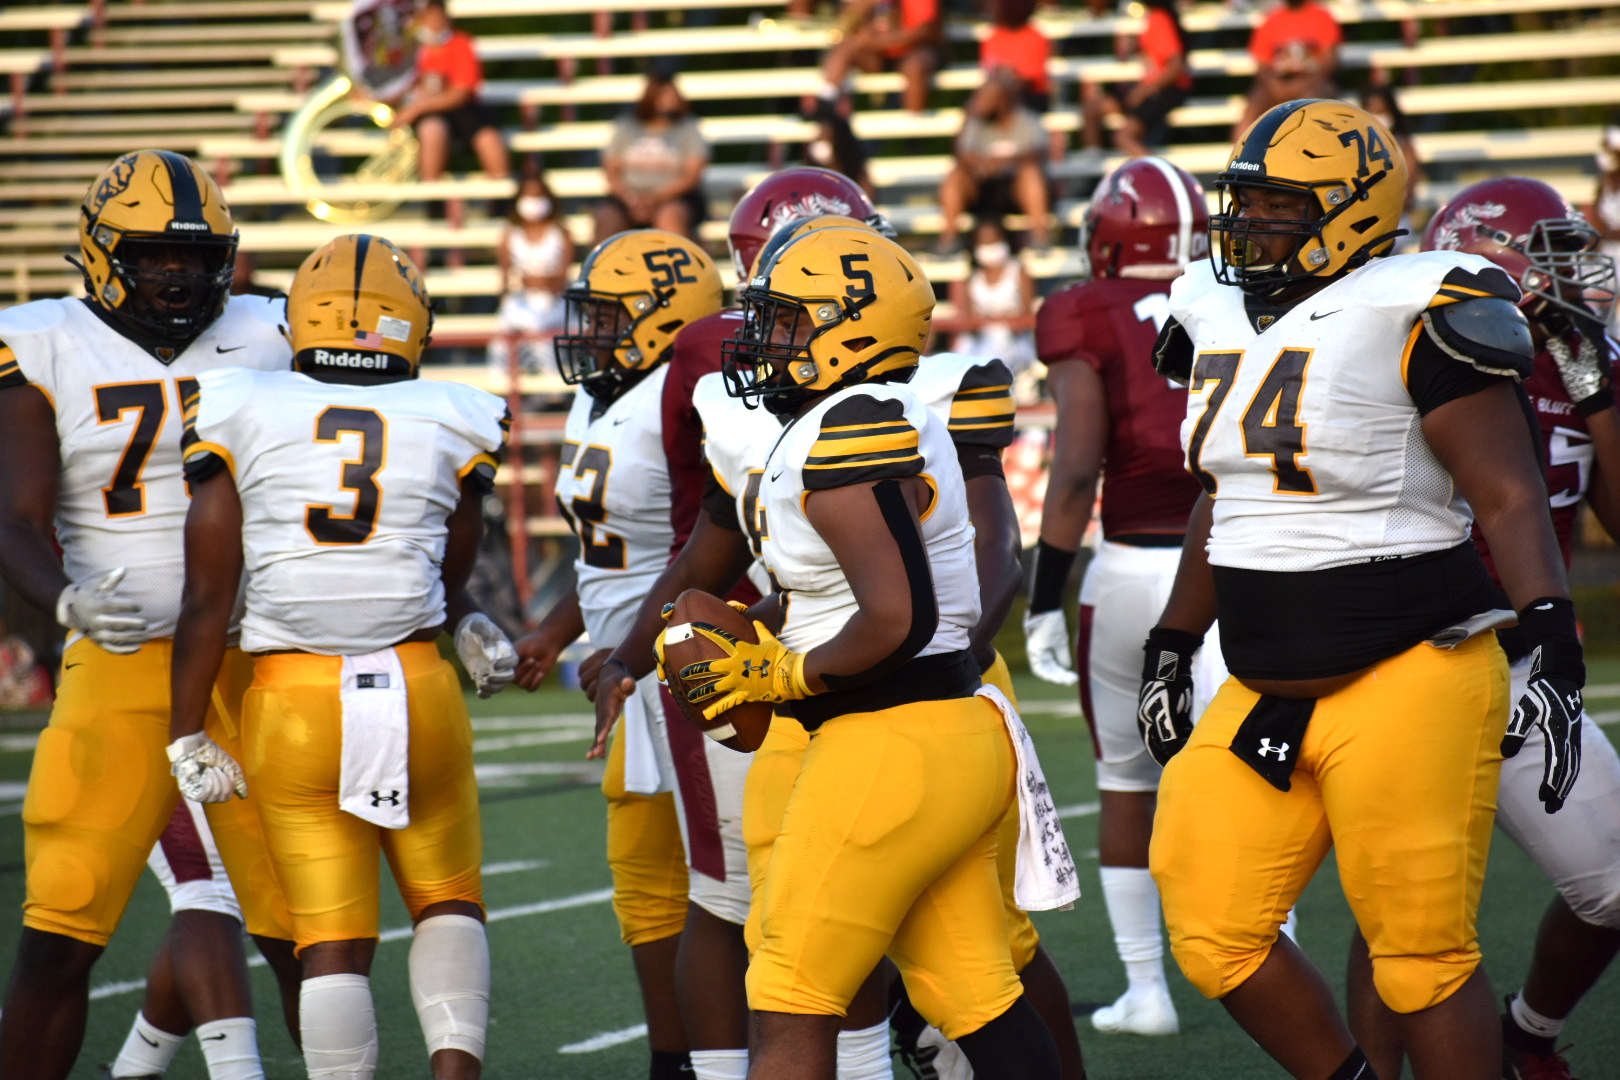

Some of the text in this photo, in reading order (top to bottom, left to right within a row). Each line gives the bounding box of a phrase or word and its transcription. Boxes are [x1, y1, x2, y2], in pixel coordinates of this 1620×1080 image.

[1337, 126, 1394, 178] 74
[642, 248, 698, 287] 52
[840, 253, 875, 298] 5
[314, 348, 389, 370] Riddell
[91, 376, 202, 519] 7
[1186, 346, 1320, 498] 74
[304, 404, 389, 546] 3
[1547, 425, 1595, 509] 5
